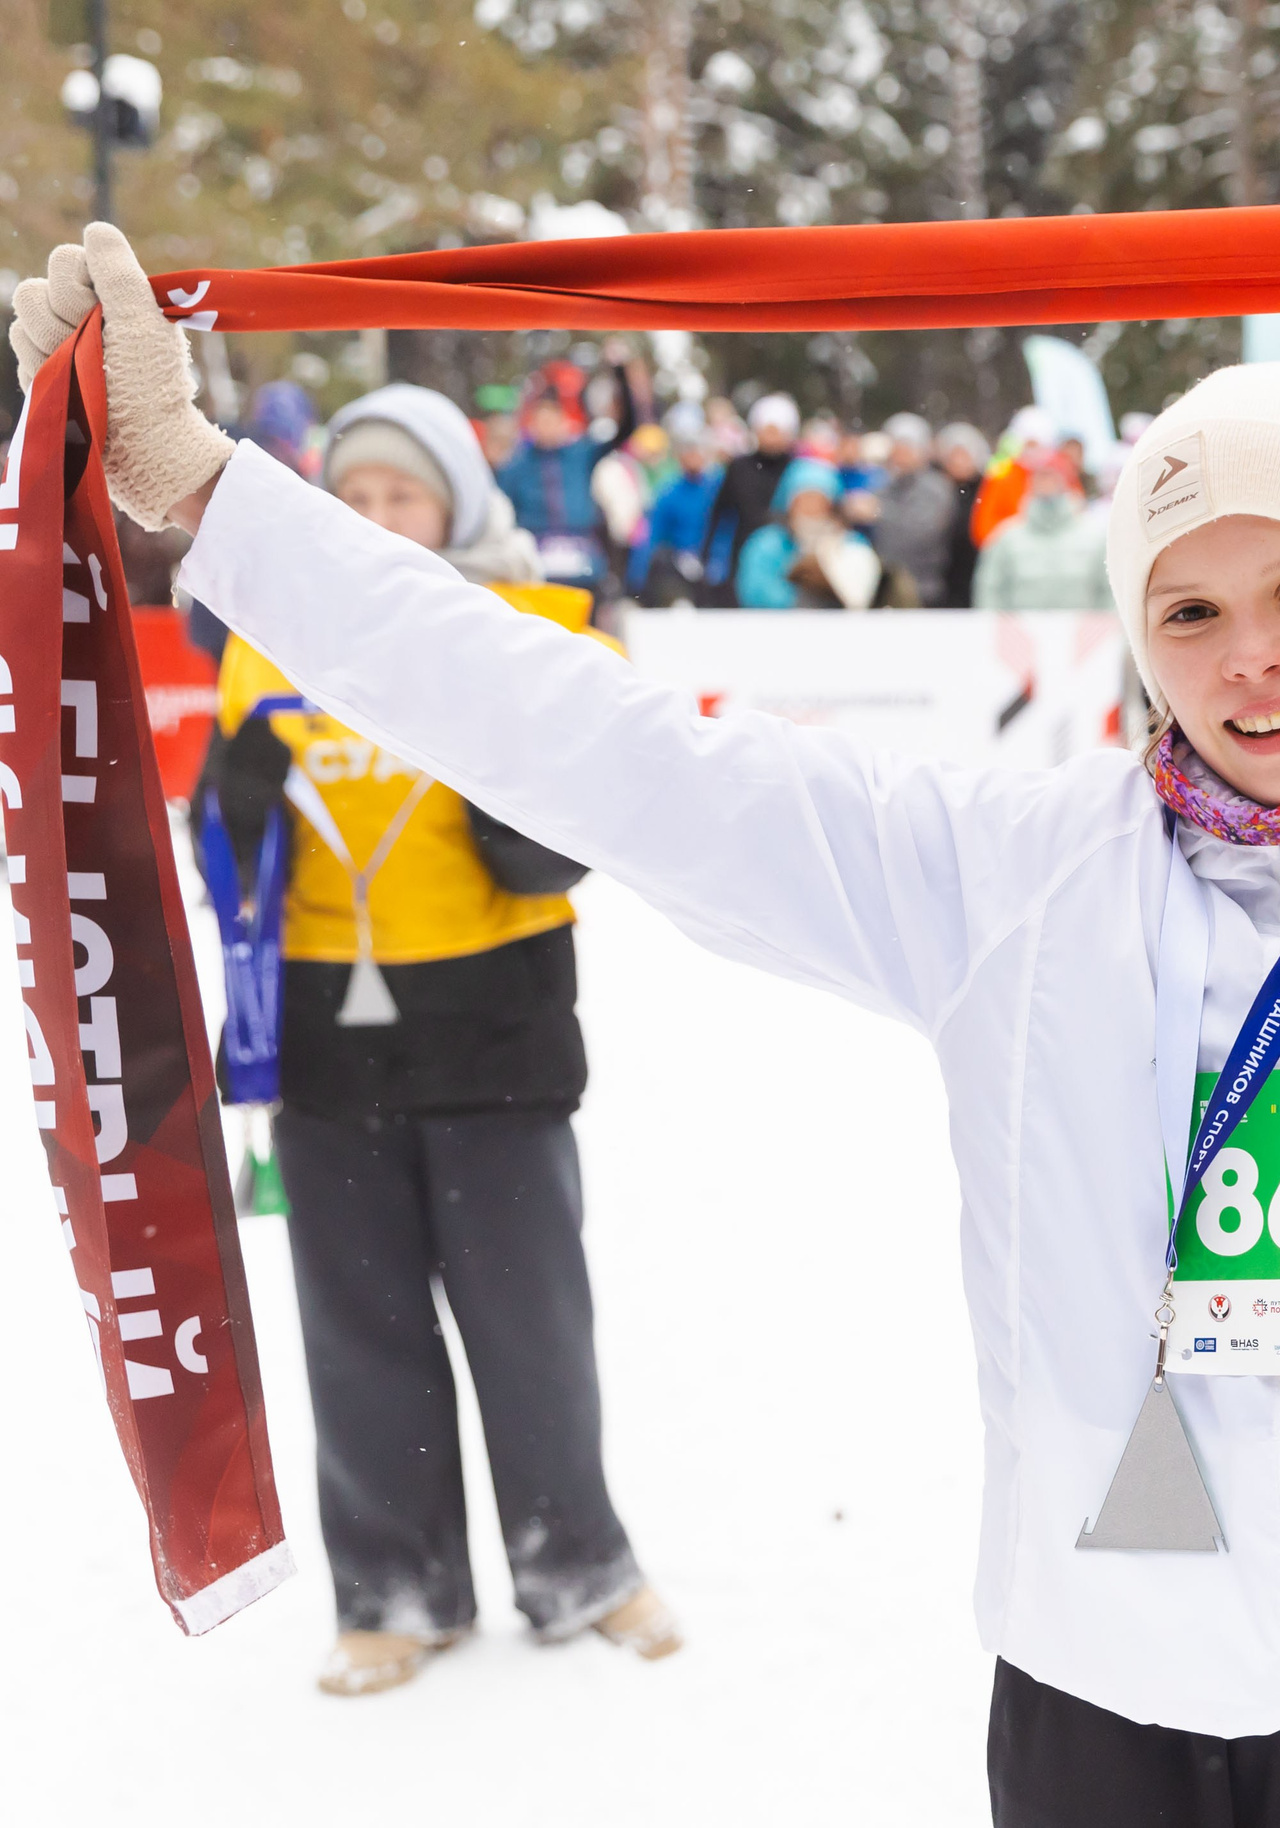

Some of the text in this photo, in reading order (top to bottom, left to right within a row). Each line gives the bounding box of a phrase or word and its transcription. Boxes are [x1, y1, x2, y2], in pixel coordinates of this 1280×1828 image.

[1157, 492, 1199, 515] DEMIX
[1193, 1109, 1229, 1172] СПОРТ
[1239, 1339, 1259, 1348] HAS
